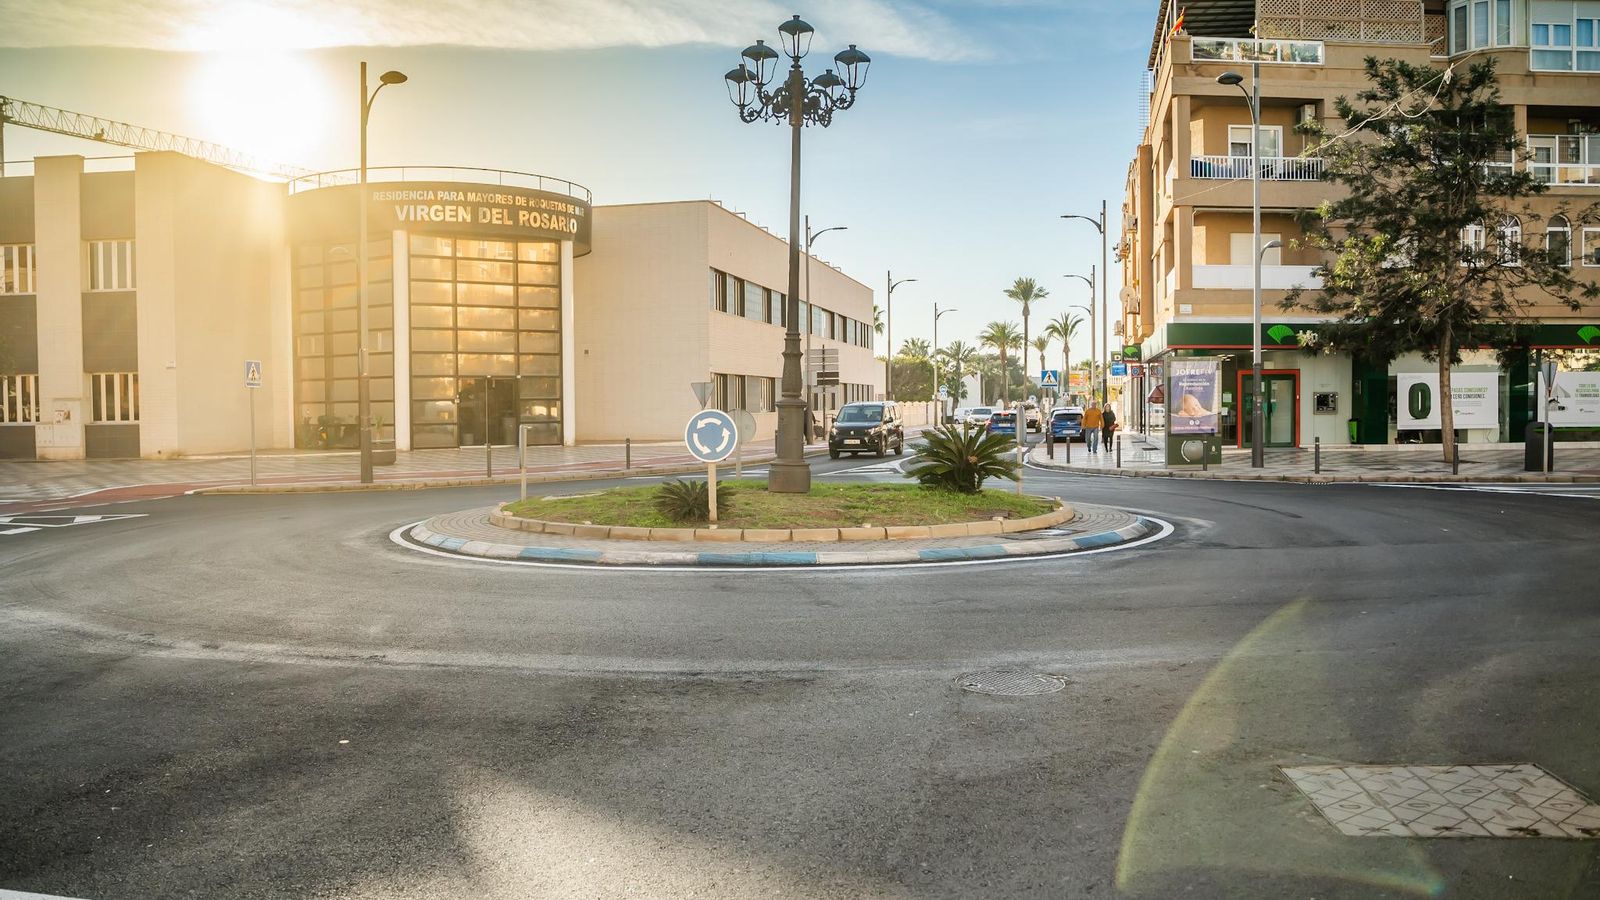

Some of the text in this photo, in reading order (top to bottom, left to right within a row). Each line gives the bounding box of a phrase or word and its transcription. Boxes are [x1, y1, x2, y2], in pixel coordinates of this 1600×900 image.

[373, 191, 435, 201] RESIDENCIA
[437, 191, 465, 201] PARA
[467, 192, 513, 205] MAYORES
[515, 196, 527, 206] DE
[529, 197, 566, 212] ROQUETAS
[567, 204, 575, 214] DE
[395, 205, 577, 234] VIRGEN DEL ROSARIO
